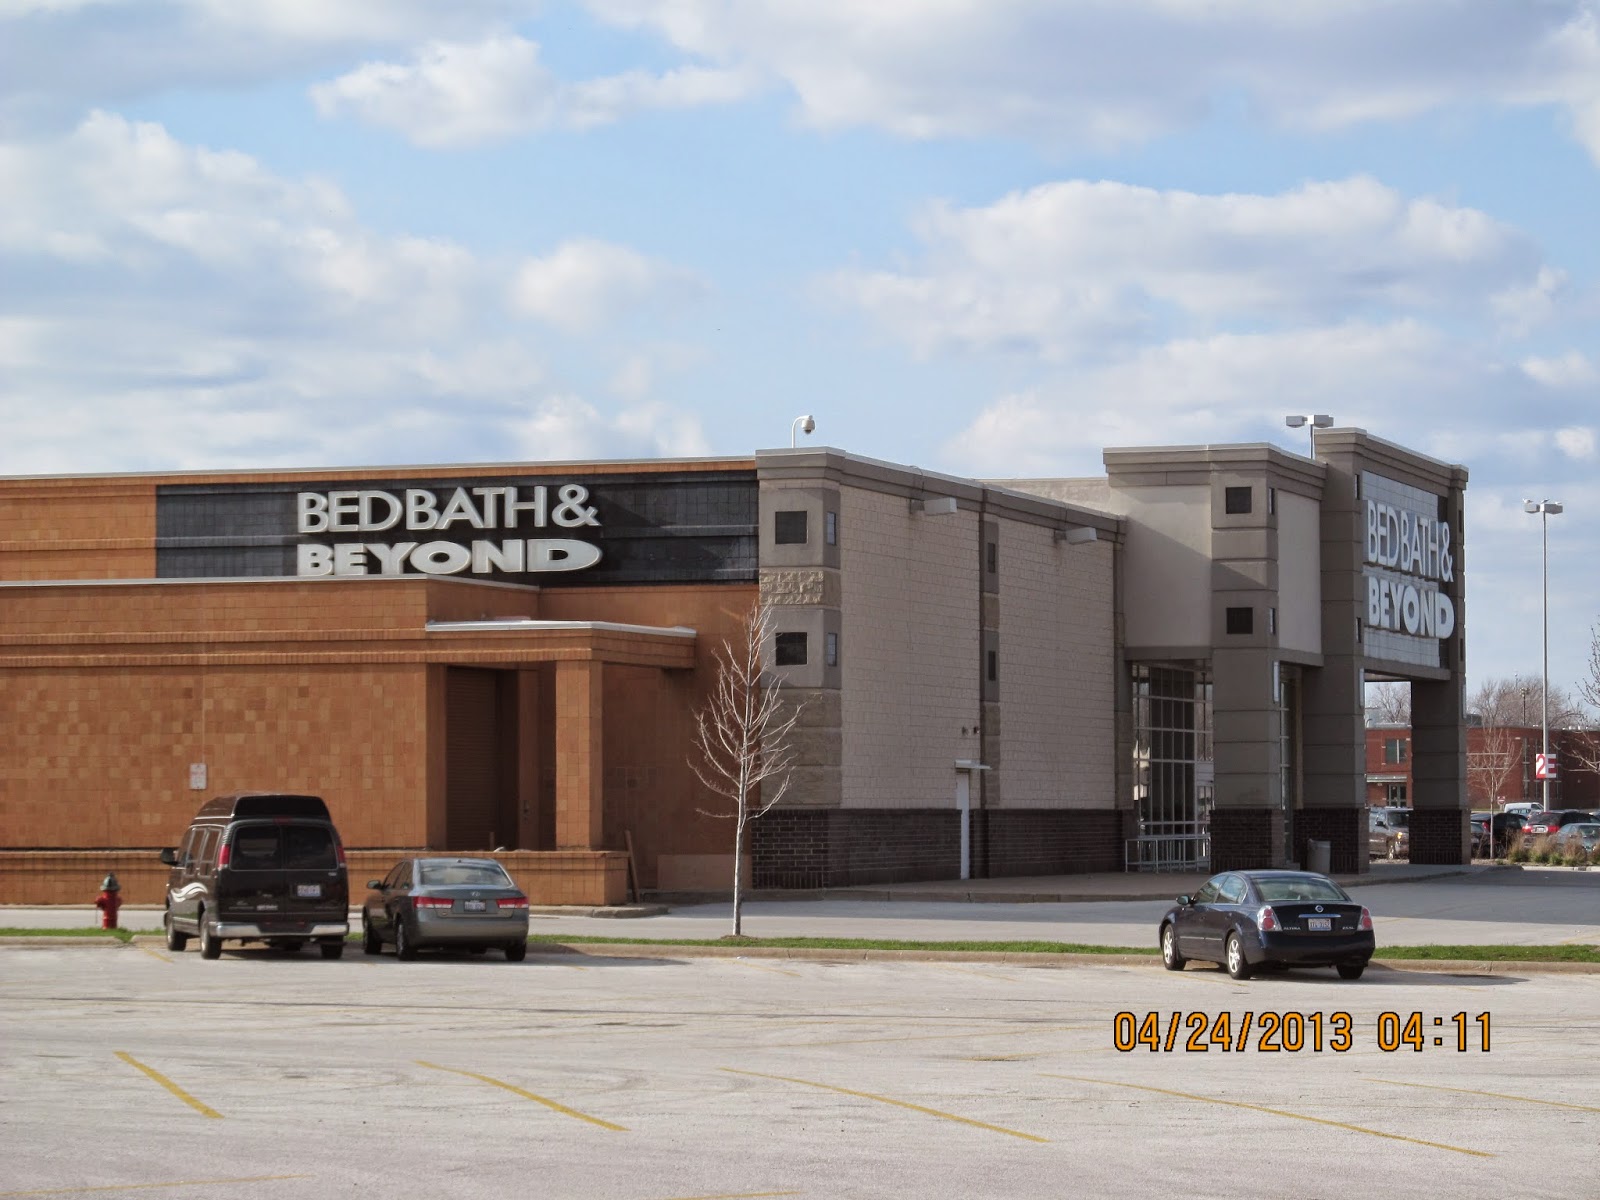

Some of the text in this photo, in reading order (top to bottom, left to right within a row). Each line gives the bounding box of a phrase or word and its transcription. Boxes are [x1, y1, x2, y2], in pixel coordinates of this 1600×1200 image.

[298, 484, 602, 533] BED BATH &
[298, 539, 602, 576] BEYOND
[1368, 500, 1454, 582] BED BATH &
[1368, 576, 1454, 639] BEYOND
